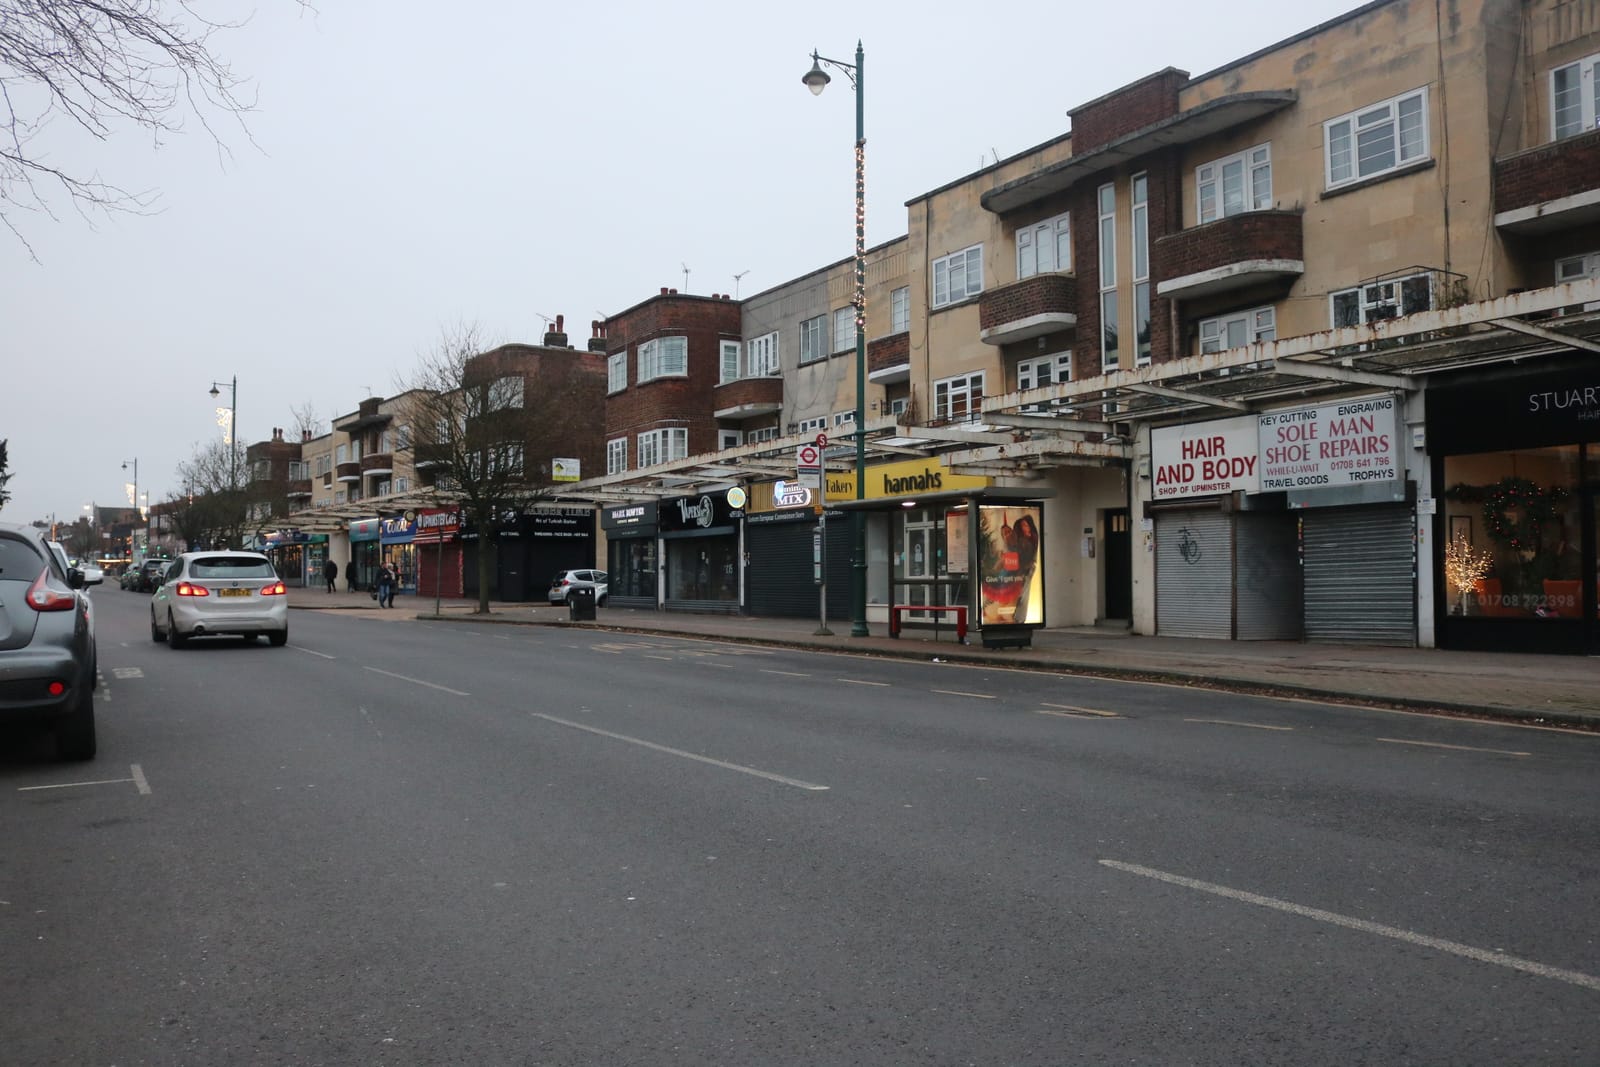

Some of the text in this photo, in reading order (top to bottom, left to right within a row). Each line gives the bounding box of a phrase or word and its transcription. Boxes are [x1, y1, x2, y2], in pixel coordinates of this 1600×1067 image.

[1338, 400, 1392, 416] ENGRAVING
[1261, 410, 1317, 426] KEY CUTTING
[1277, 415, 1375, 444] SOLE MAN
[819, 435, 826, 446] S
[1182, 436, 1225, 460] HAIR
[1266, 434, 1389, 465] SHOE REPAIRS
[1156, 455, 1257, 486] AND BODY
[1266, 463, 1320, 477] WHILE-U-WAIT
[1331, 457, 1390, 471] 01708 641 796
[884, 468, 942, 494] hannahs
[1264, 475, 1329, 489] TRAVEL GOODS
[1349, 469, 1394, 481] TROPHYS
[1159, 482, 1231, 496] SHOP OF UPMINSTER
[777, 493, 804, 506] MIX
[1479, 594, 1519, 607] 01708
[1523, 593, 1576, 608] 722398
